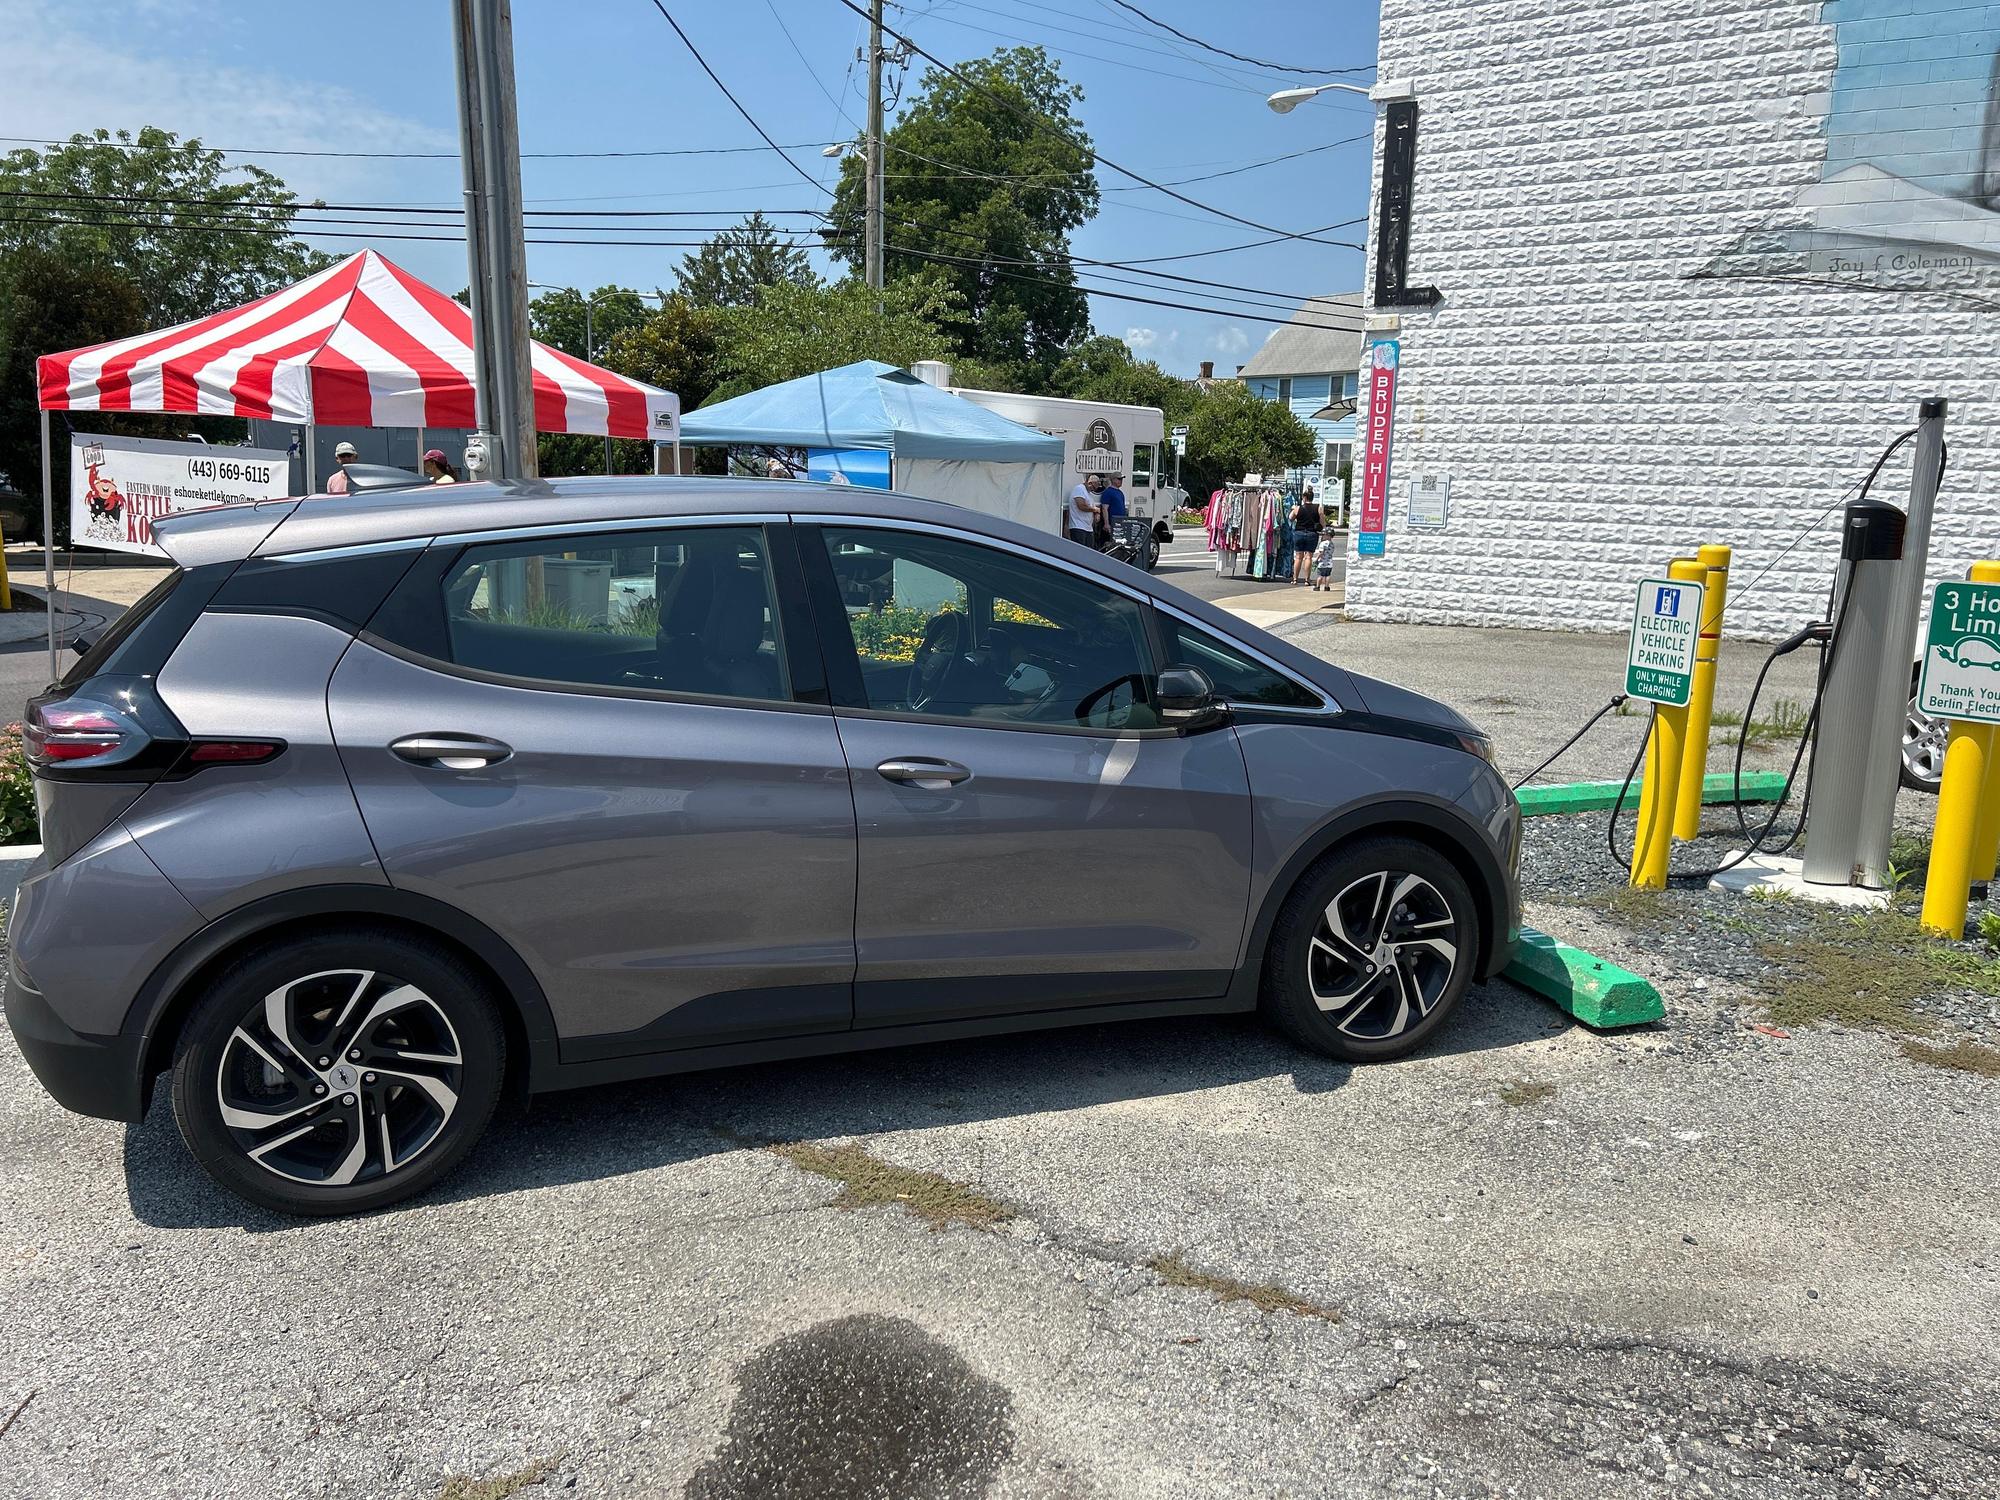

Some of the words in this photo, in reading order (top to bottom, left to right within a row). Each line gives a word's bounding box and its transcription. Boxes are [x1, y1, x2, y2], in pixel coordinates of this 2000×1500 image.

[1828, 257, 1863, 281] Jay
[1892, 254, 1973, 275] Coleman
[1372, 376, 1389, 455] BRUDER
[188, 459, 217, 482] (443)
[219, 463, 270, 484] 669-6115
[1078, 454, 1097, 470] STREET
[1099, 455, 1120, 471] KITCHEN
[126, 482, 151, 494] EASTERN
[152, 485, 171, 496] SHORE
[174, 486, 268, 504] eshorekettlekorn@
[1368, 462, 1382, 512] HILL
[126, 514, 156, 545] KO
[1944, 590, 1960, 610] 3
[1640, 616, 1691, 634] ELECTRIC
[1951, 612, 2000, 635] Lim
[1641, 633, 1686, 652] VEHICLE
[1638, 650, 1685, 669] PARKING
[1636, 670, 1655, 682] ONLY
[1658, 673, 1682, 687] WHILE
[1637, 682, 1676, 698] CHARGING
[1940, 683, 1975, 698] Thank
[1980, 687, 2000, 700] You
[1929, 695, 1963, 710] Berlin
